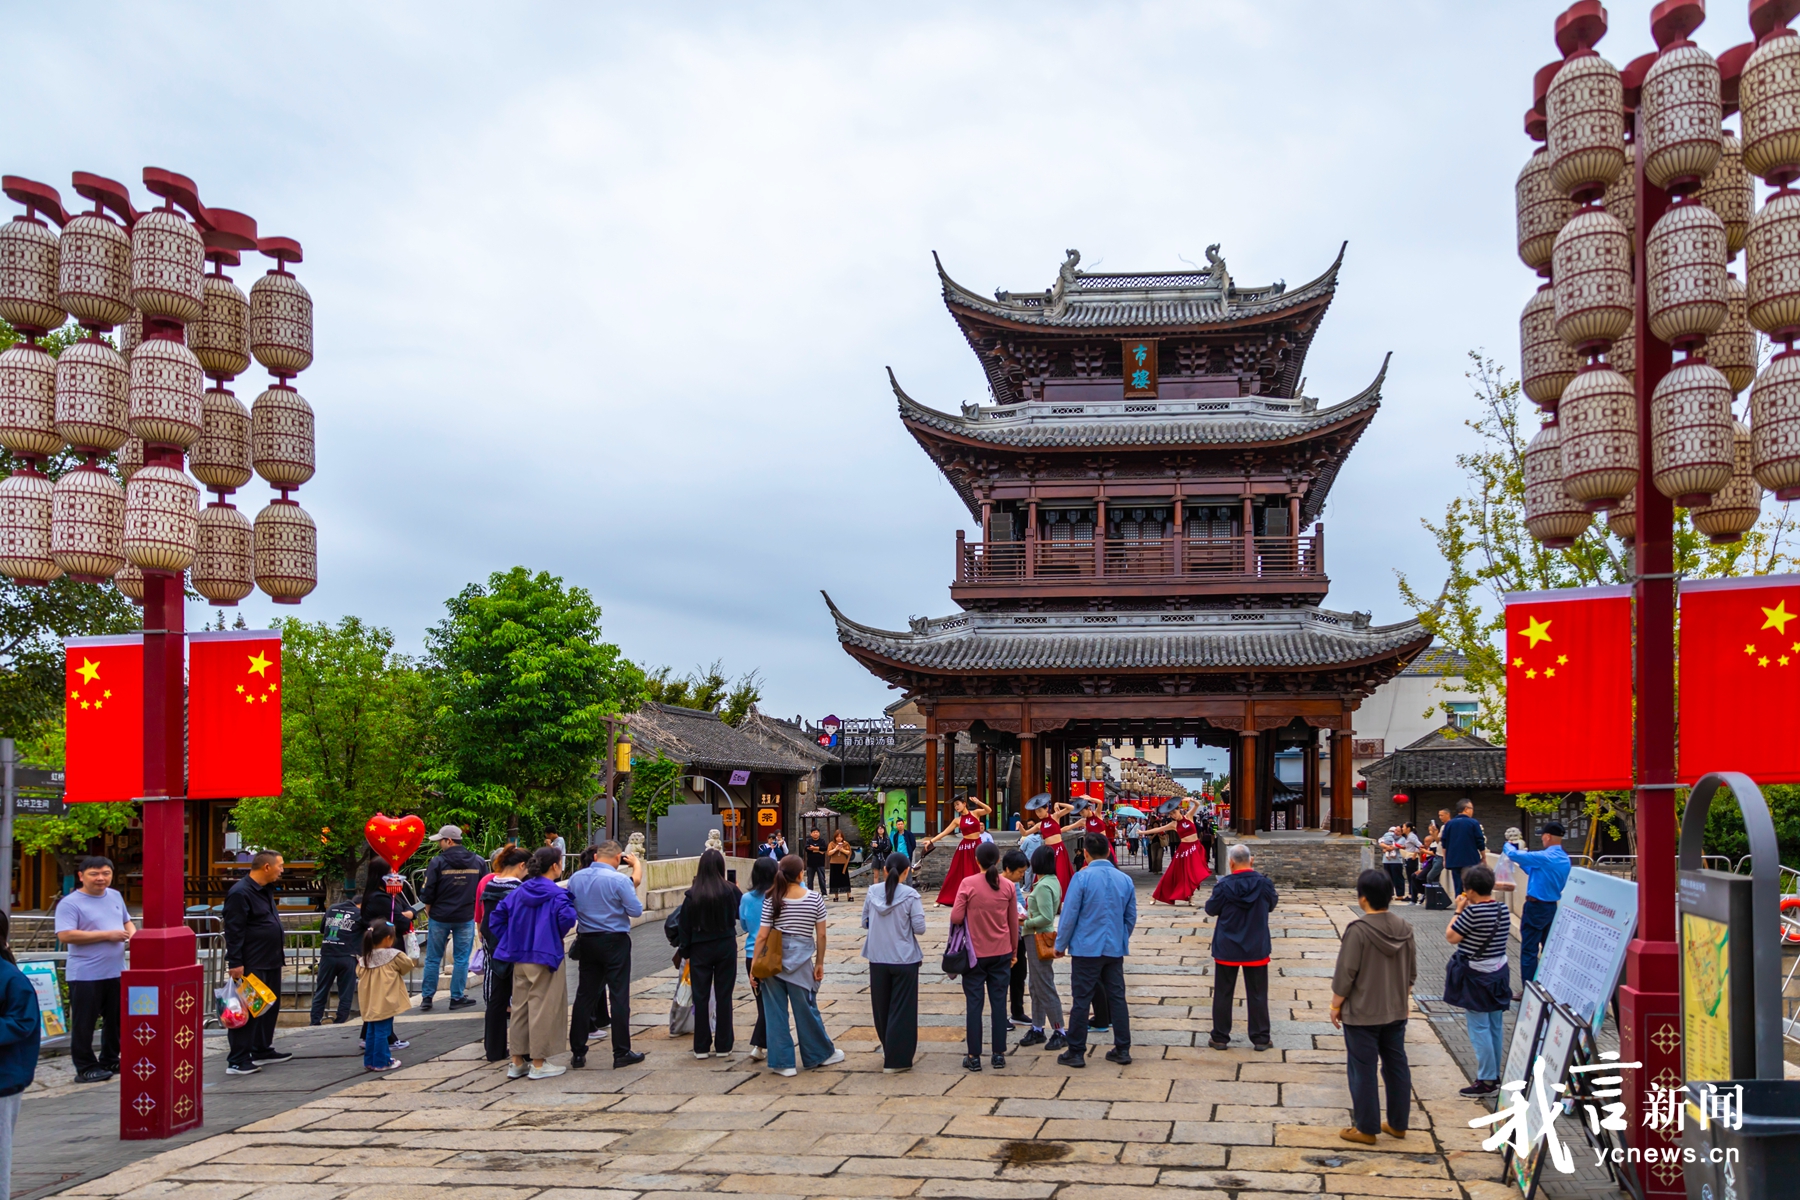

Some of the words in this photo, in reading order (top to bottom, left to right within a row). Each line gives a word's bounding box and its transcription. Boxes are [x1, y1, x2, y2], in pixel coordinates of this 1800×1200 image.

[844, 736, 895, 746] 番茄酸汤鱼
[16, 799, 50, 809] 公共卫生间
[761, 812, 773, 822] 茶
